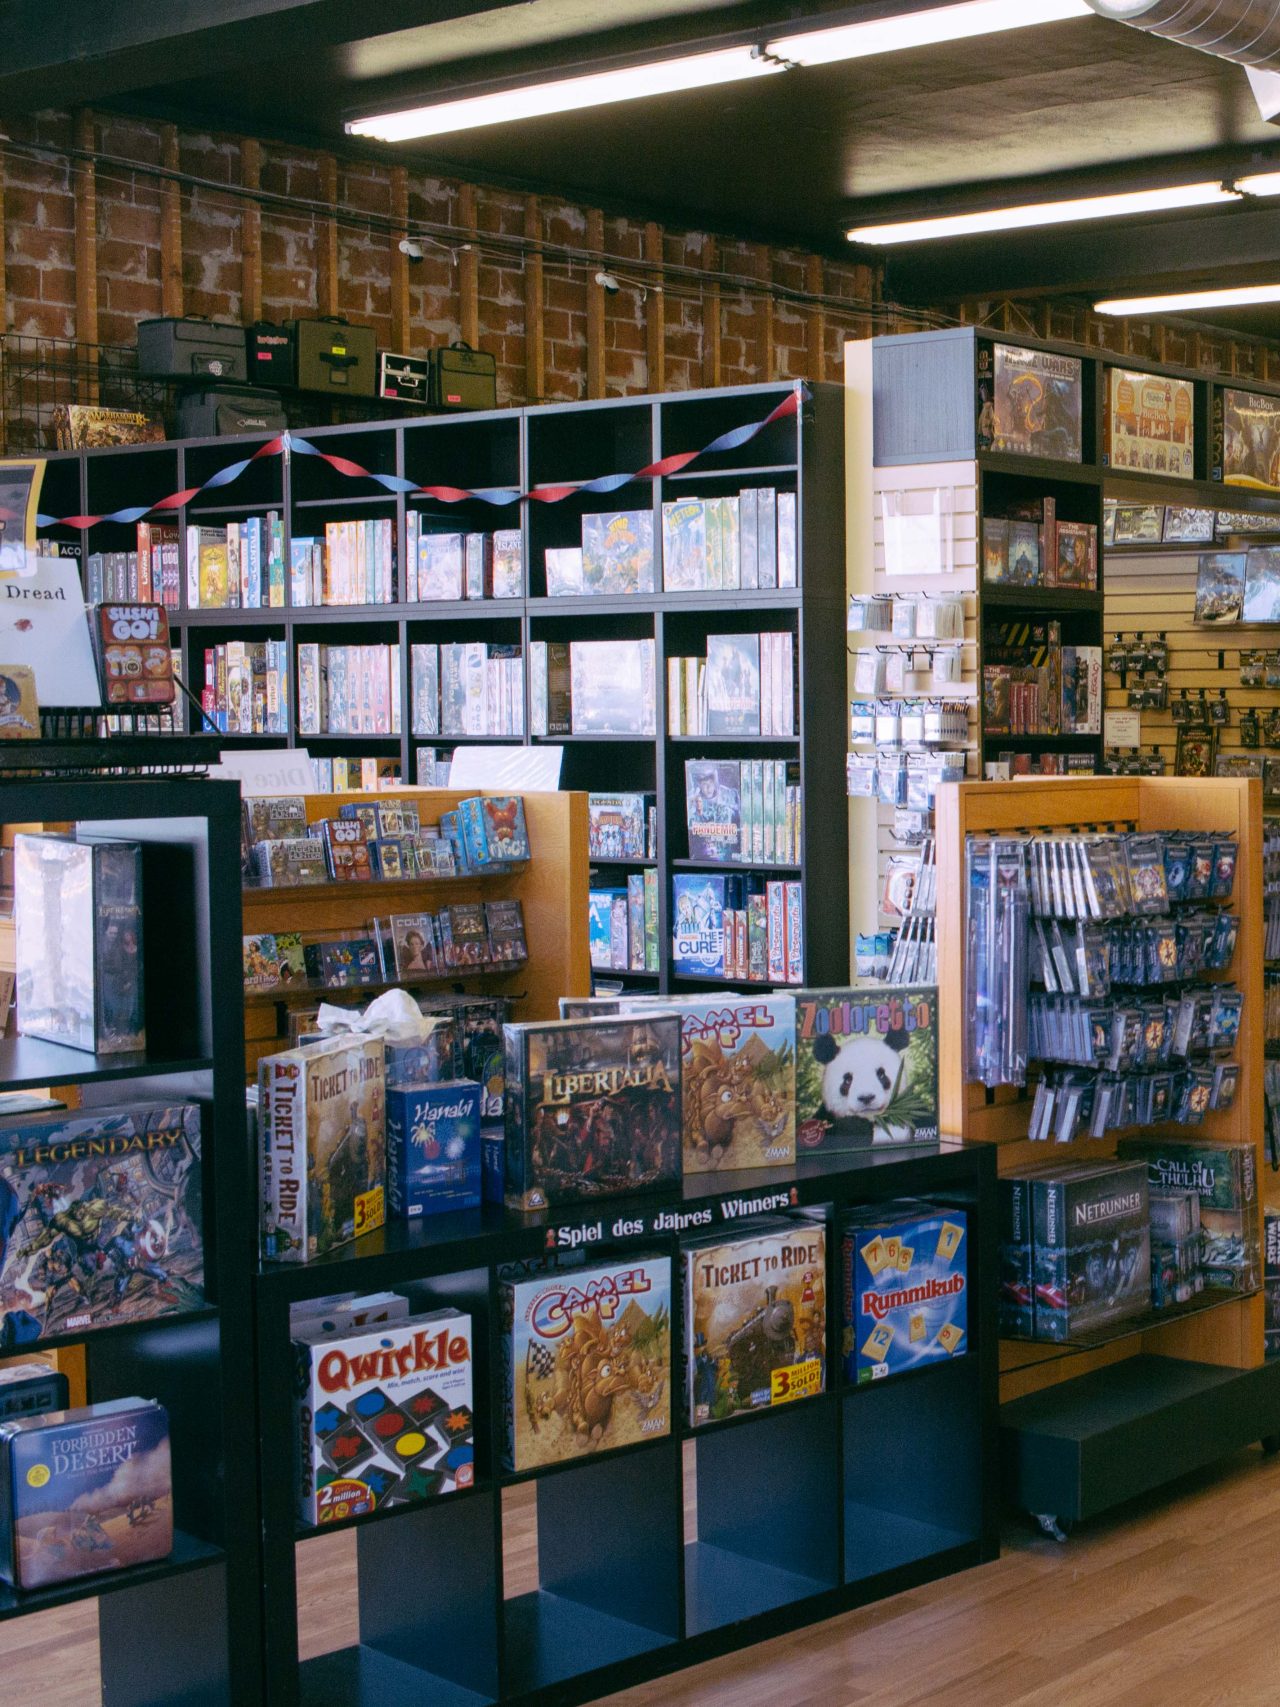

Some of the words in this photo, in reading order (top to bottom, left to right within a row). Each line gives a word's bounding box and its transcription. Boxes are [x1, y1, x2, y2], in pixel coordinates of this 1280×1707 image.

[1041, 357, 1075, 374] WARS
[6, 584, 66, 601] Dread
[109, 606, 159, 622] SUSHI
[112, 618, 159, 640] GO!
[332, 821, 361, 831] SUSHI
[335, 829, 360, 841] GO!
[692, 823, 738, 836] PANDEMIC
[700, 932, 718, 941] THE
[679, 942, 718, 954] CURE
[800, 999, 931, 1039] Zooloretto
[312, 1068, 348, 1102] TICKET
[359, 1057, 381, 1084] RIDE
[541, 1060, 674, 1107] LIBERTALIA
[274, 1083, 297, 1153] TICKET
[415, 1099, 473, 1122] Hanabi
[17, 1128, 183, 1168] LEGENDARY
[280, 1158, 293, 1175] TO
[278, 1179, 300, 1225] RIDE
[1075, 1193, 1142, 1225] NETRUNNER
[356, 1199, 366, 1229] 3
[558, 1222, 602, 1248] Spiel
[612, 1217, 643, 1238] des
[653, 1207, 712, 1231] Jahres
[721, 1192, 789, 1220] Winners
[1047, 1189, 1056, 1245] NETRUNNER
[946, 1231, 954, 1247] 1
[1267, 1220, 1278, 1265] WARS
[888, 1244, 895, 1258] 6
[902, 1252, 908, 1265] 5
[701, 1259, 760, 1289] TICKET
[765, 1256, 779, 1270] TO
[781, 1243, 818, 1269] RIDE
[532, 1268, 652, 1338] CAMEL
[862, 1271, 966, 1320] Rummikub
[66, 1314, 91, 1328] MARVEL
[873, 1329, 890, 1346] 12
[317, 1328, 471, 1394] Qwirkle
[791, 1360, 820, 1376] MILLION
[440, 1369, 452, 1377] and
[791, 1370, 820, 1390] SOLD!
[773, 1371, 791, 1398] 3
[52, 1425, 137, 1456] FORBIDDEN
[53, 1440, 138, 1476] DESERT
[320, 1486, 333, 1506] 2
[333, 1489, 361, 1503] million
